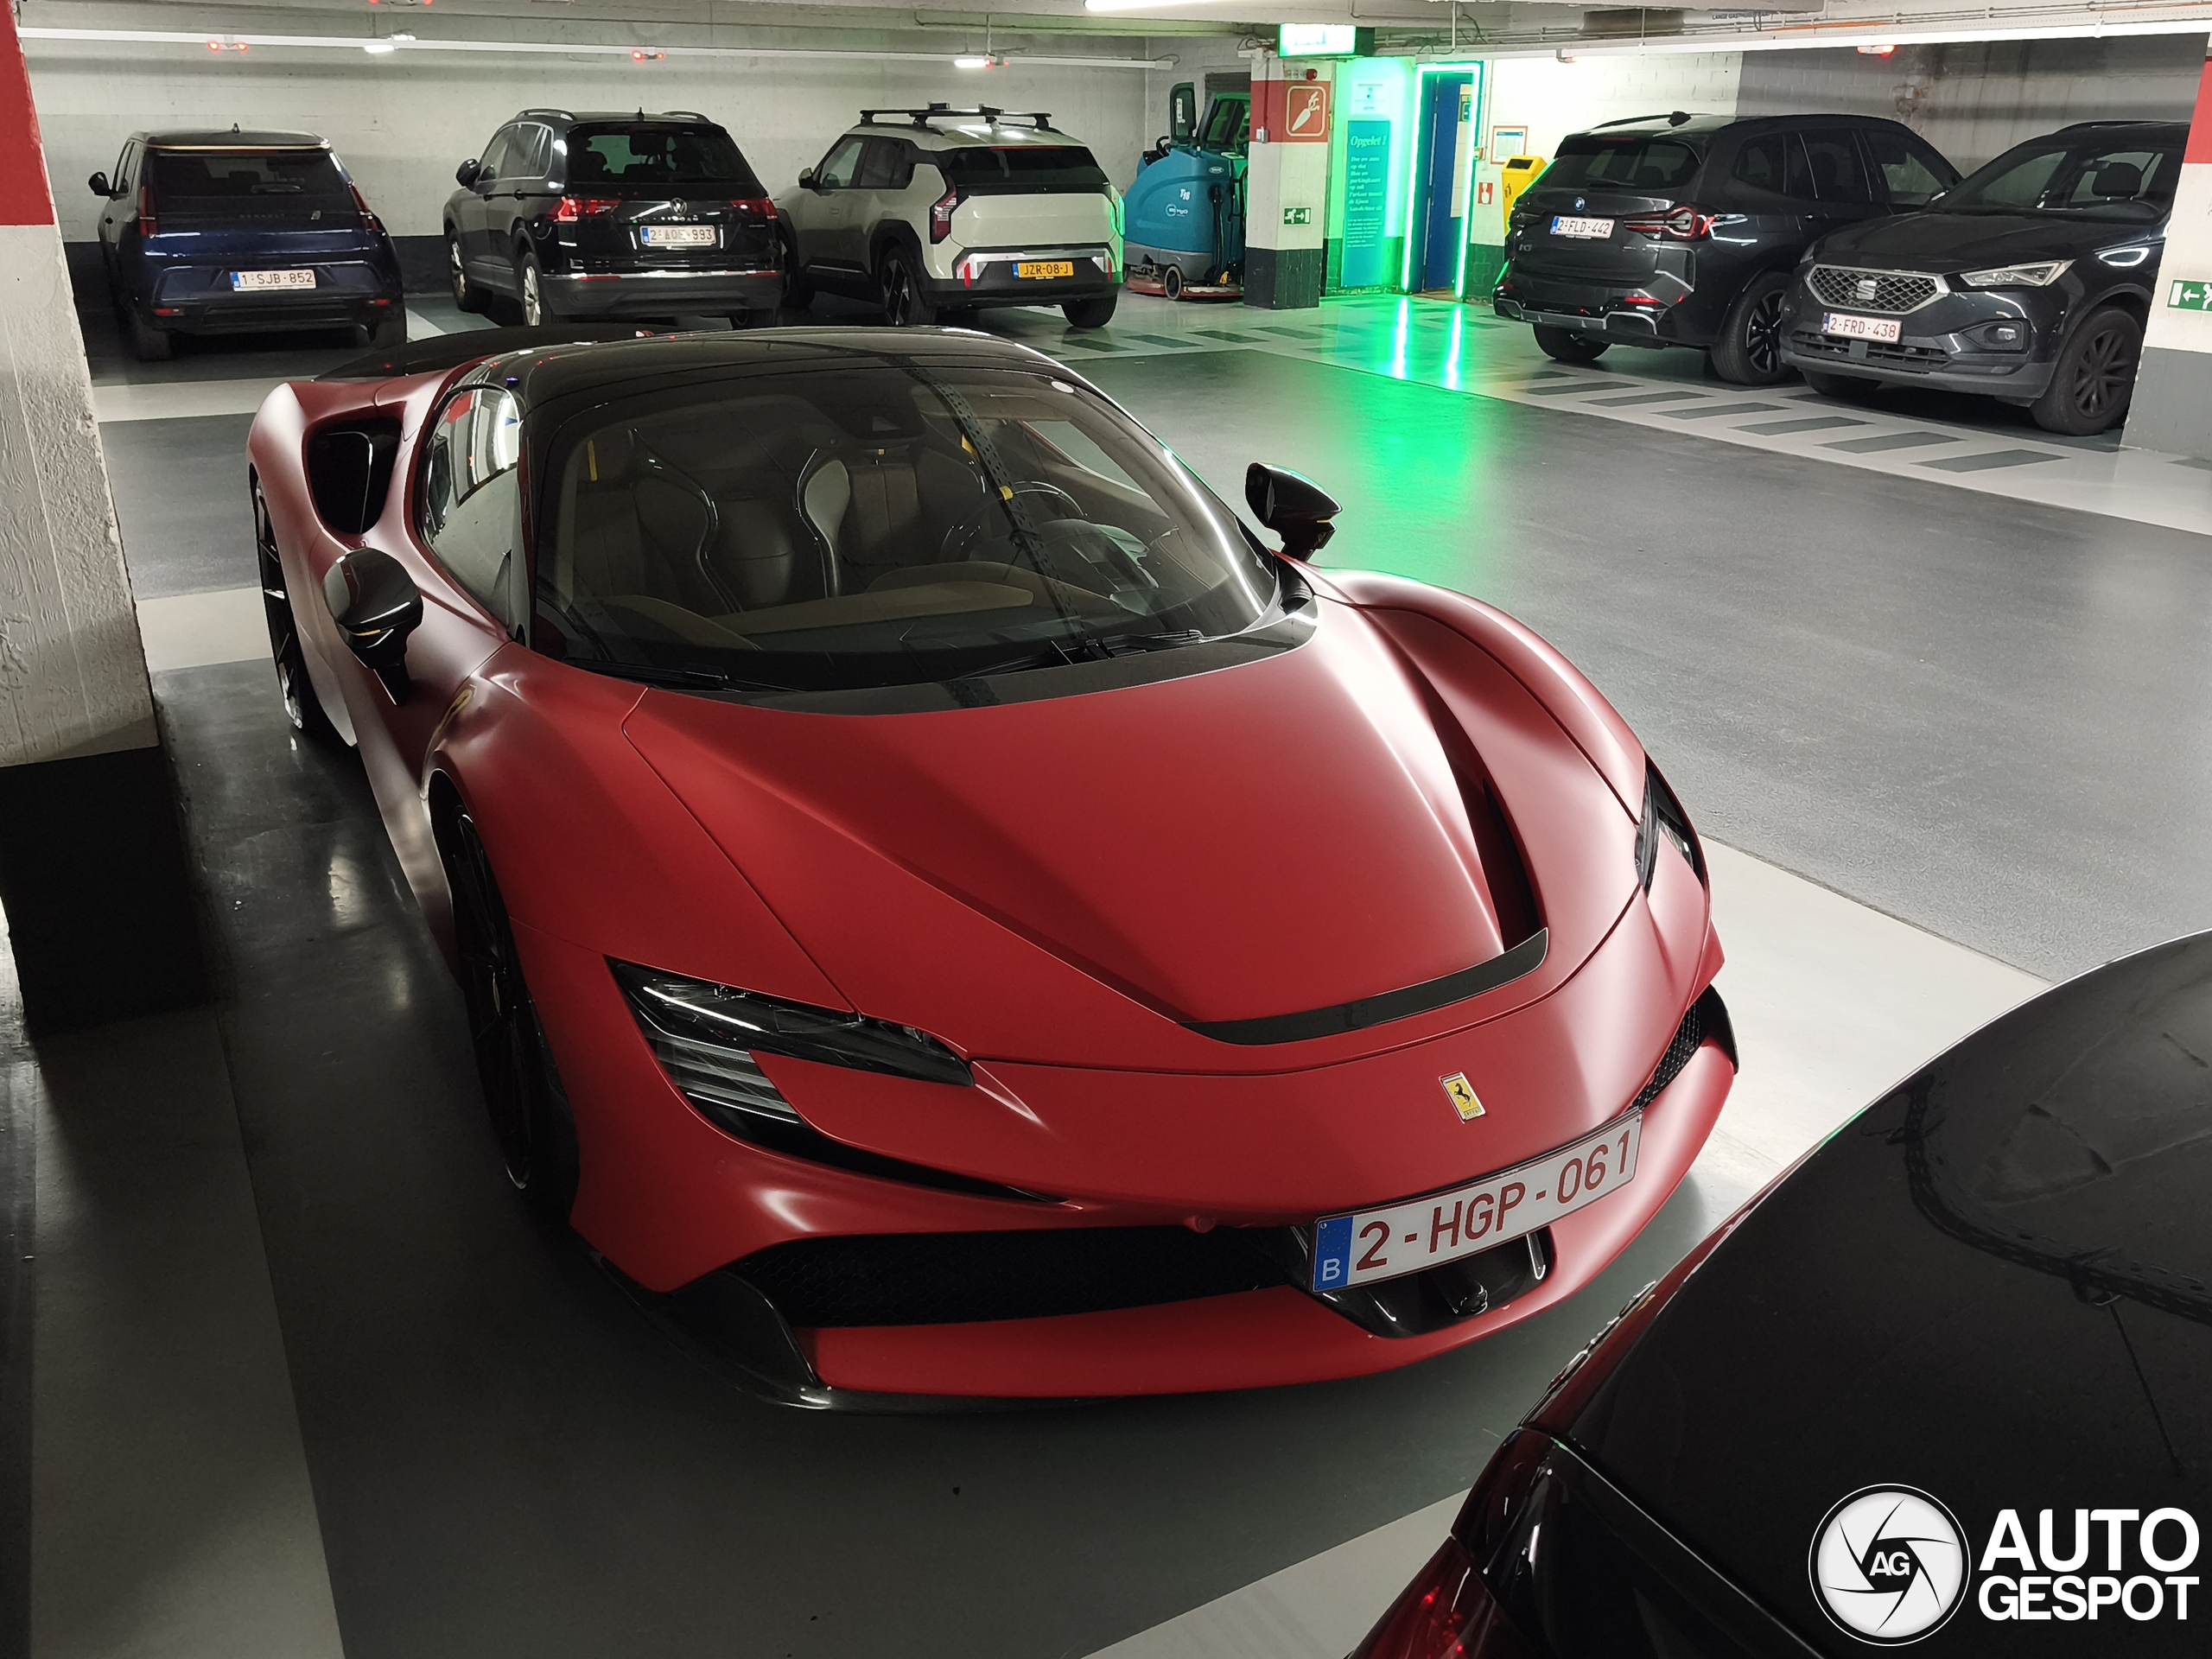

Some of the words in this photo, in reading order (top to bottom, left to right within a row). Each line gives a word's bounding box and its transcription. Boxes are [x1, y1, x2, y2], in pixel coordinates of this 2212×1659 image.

[1350, 135, 1382, 149] Opgelet
[242, 272, 314, 285] 1-SJB-852
[1024, 264, 1069, 276] JZR-08-J
[1830, 317, 1897, 338] 2-FRD-438
[1355, 1128, 1631, 1271] 2-HGP-061
[1321, 1258, 1341, 1282] B
